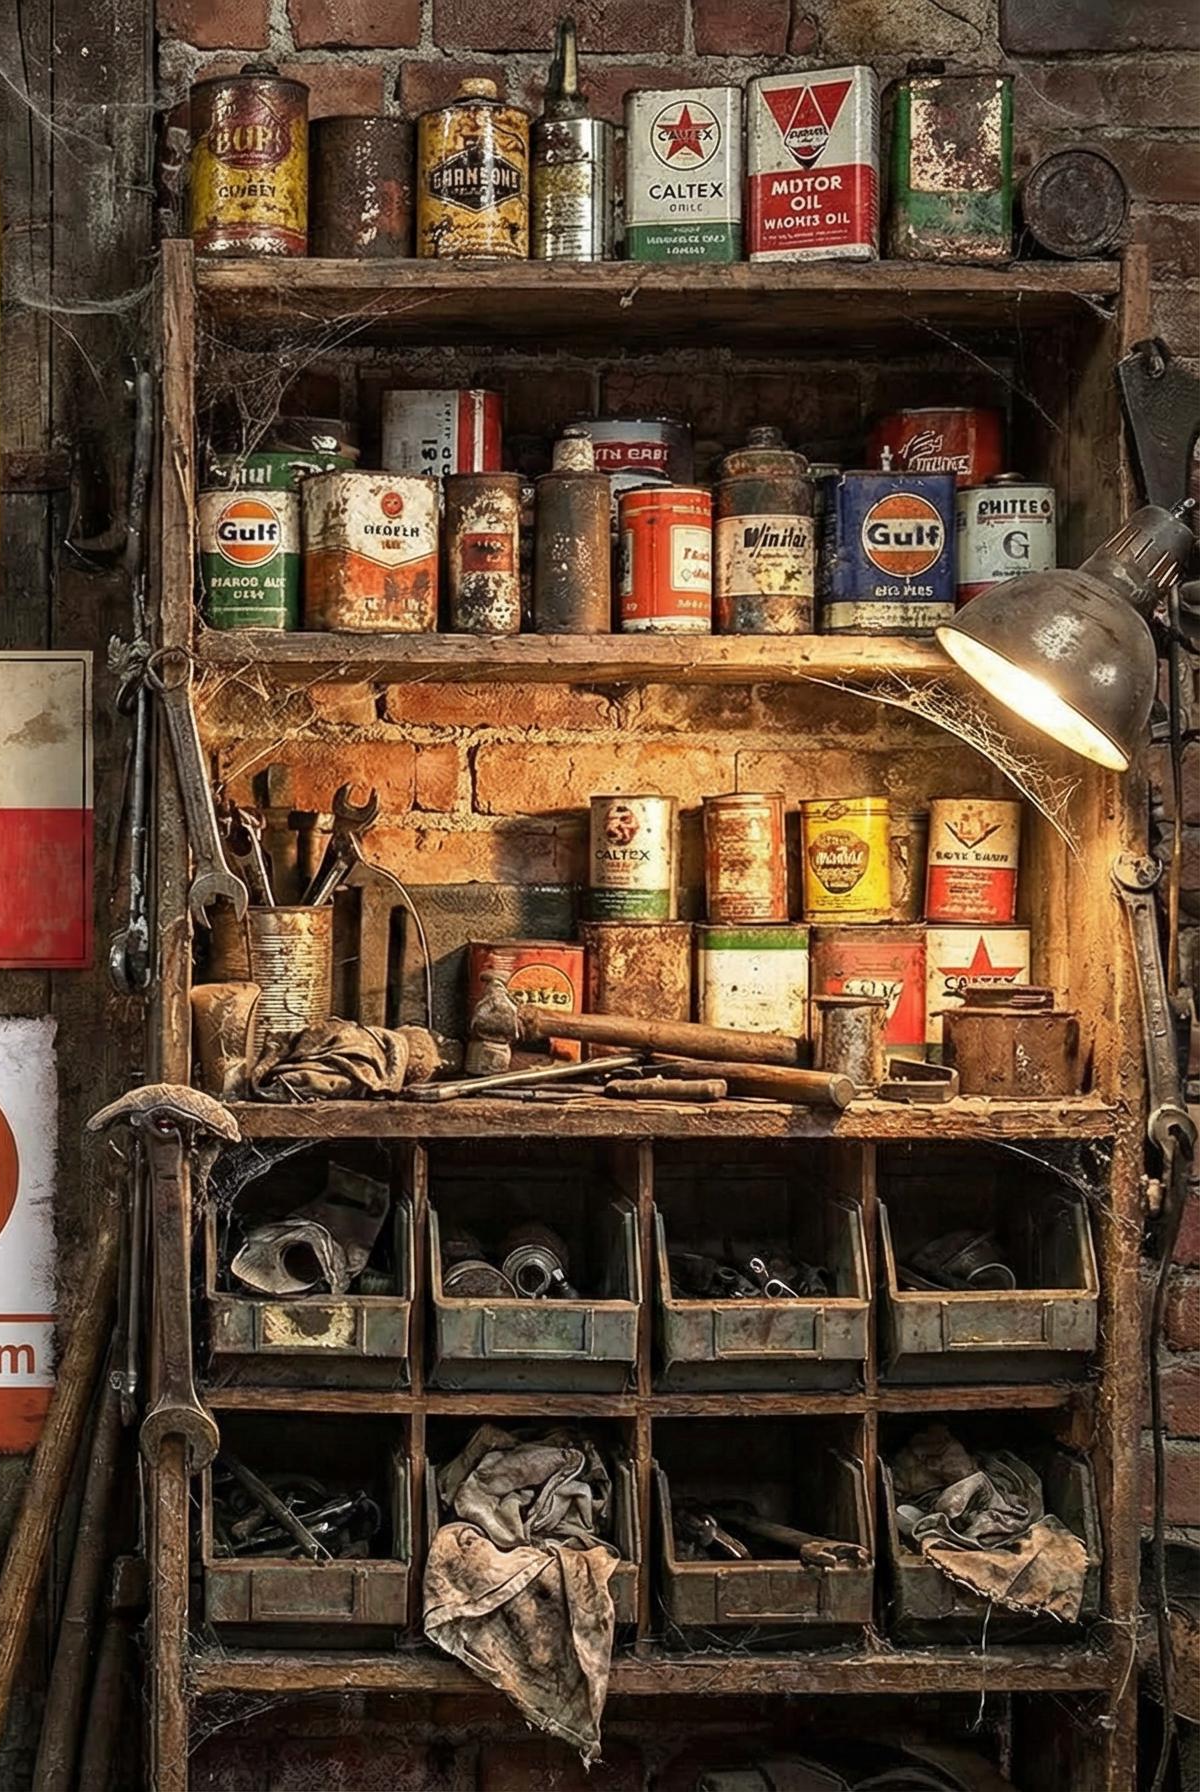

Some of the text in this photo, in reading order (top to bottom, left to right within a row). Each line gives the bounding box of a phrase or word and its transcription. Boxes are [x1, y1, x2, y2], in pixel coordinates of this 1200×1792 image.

[649, 182, 724, 201] CALTEX
[790, 194, 822, 211] OIL
[825, 212, 850, 225] OIL
[218, 521, 277, 541] Gulf
[867, 522, 940, 546] Gulf
[1003, 531, 1030, 560] G
